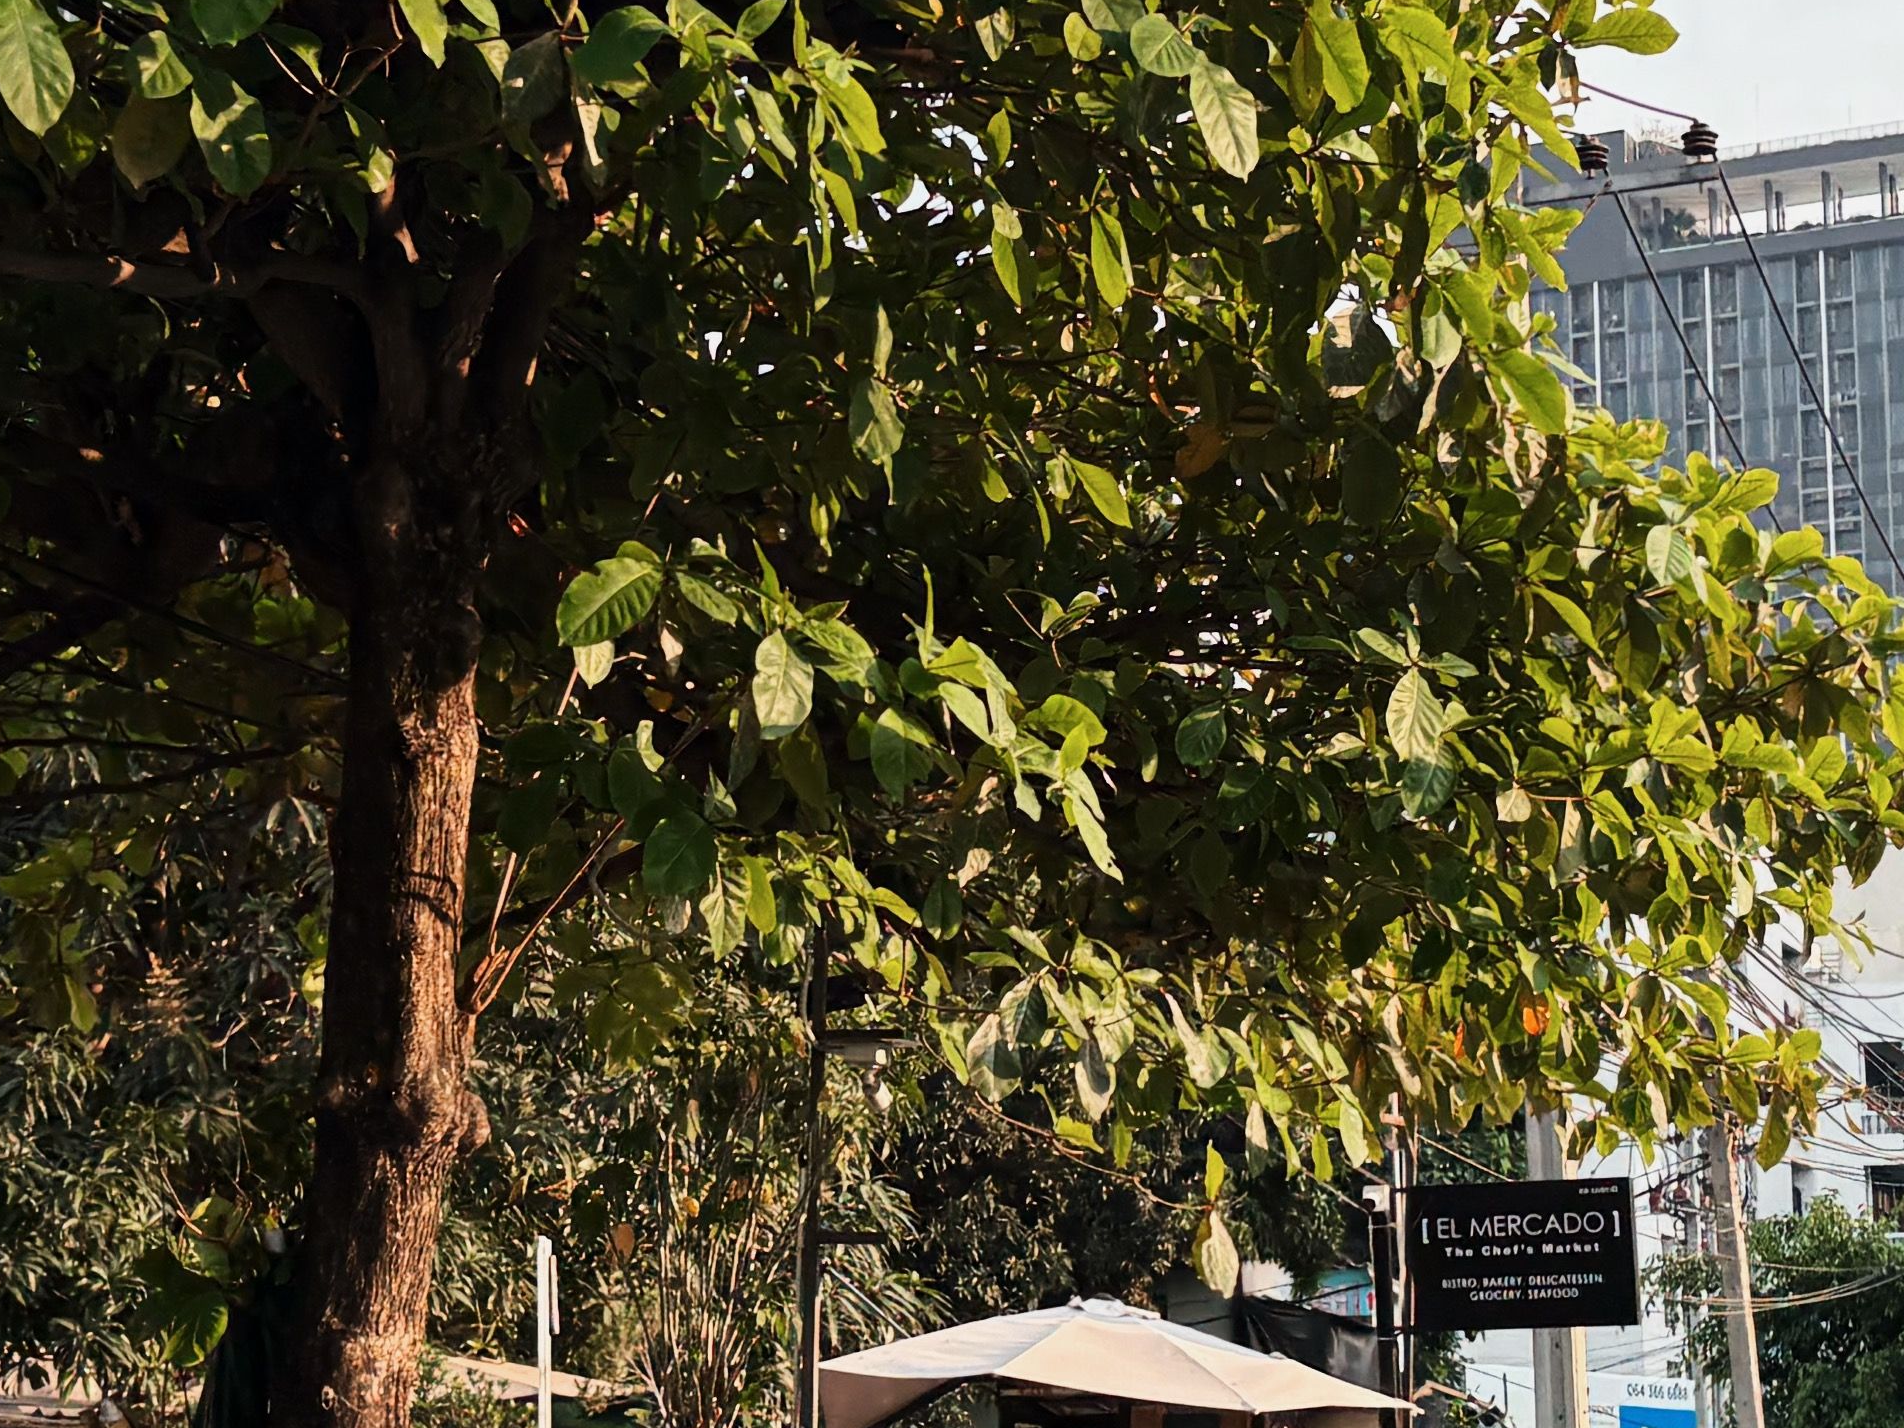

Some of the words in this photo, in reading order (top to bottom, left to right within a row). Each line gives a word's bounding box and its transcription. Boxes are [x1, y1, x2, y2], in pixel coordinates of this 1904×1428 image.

[1436, 1217, 1462, 1239] EL
[1470, 1211, 1605, 1237] MERCADO
[1444, 1247, 1474, 1257] The
[1482, 1244, 1534, 1256] Chef's
[1542, 1242, 1600, 1255] Market
[1528, 1288, 1579, 1300] SEAFOOD
